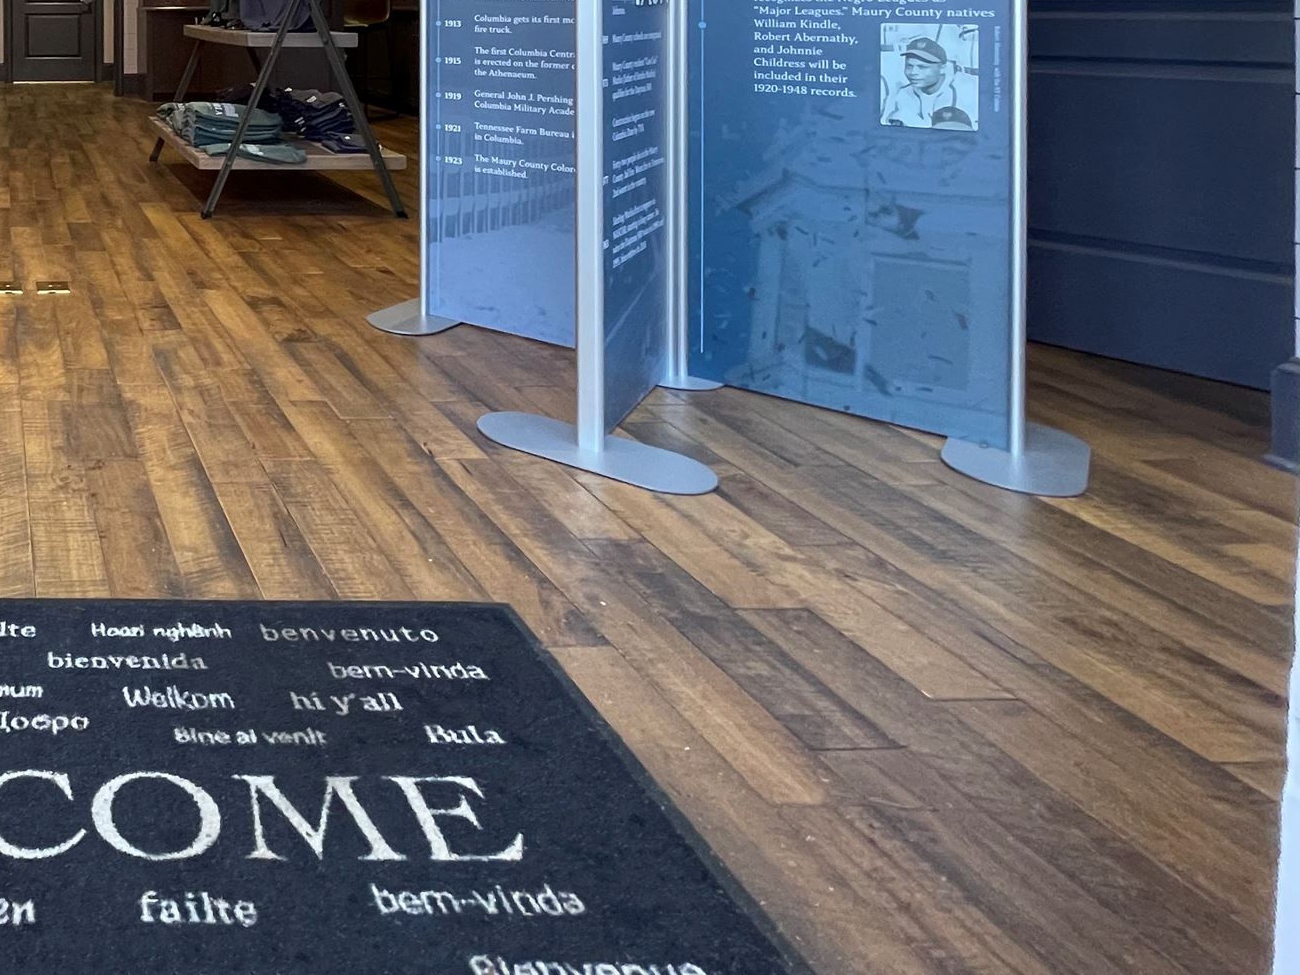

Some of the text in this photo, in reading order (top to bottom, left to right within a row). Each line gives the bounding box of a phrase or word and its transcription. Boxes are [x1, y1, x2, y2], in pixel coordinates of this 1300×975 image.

[852, 6, 892, 18] Maury
[895, 7, 942, 19] County
[947, 9, 995, 17] natives
[474, 24, 513, 33] fire truck.
[753, 18, 841, 30] William Kindle,
[754, 31, 858, 45] Robert Abernathy,
[753, 44, 822, 55] and Johnnie
[753, 57, 846, 70] Childress will be
[474, 68, 537, 79] the Athenaeum.
[754, 70, 848, 83] included in their
[445, 92, 461, 100] 1919
[754, 83, 856, 97] 1920-1948 records.
[445, 124, 461, 132] 1921
[445, 156, 462, 164] 1923
[260, 623, 439, 643] benvenuto
[47, 651, 209, 670] bienvenida
[327, 661, 491, 680] bem-vinda
[122, 685, 236, 710] Welkom
[289, 691, 326, 711] hi
[423, 724, 507, 744] Bula
[369, 882, 586, 916] bem-vinda
[139, 890, 259, 928] failte
